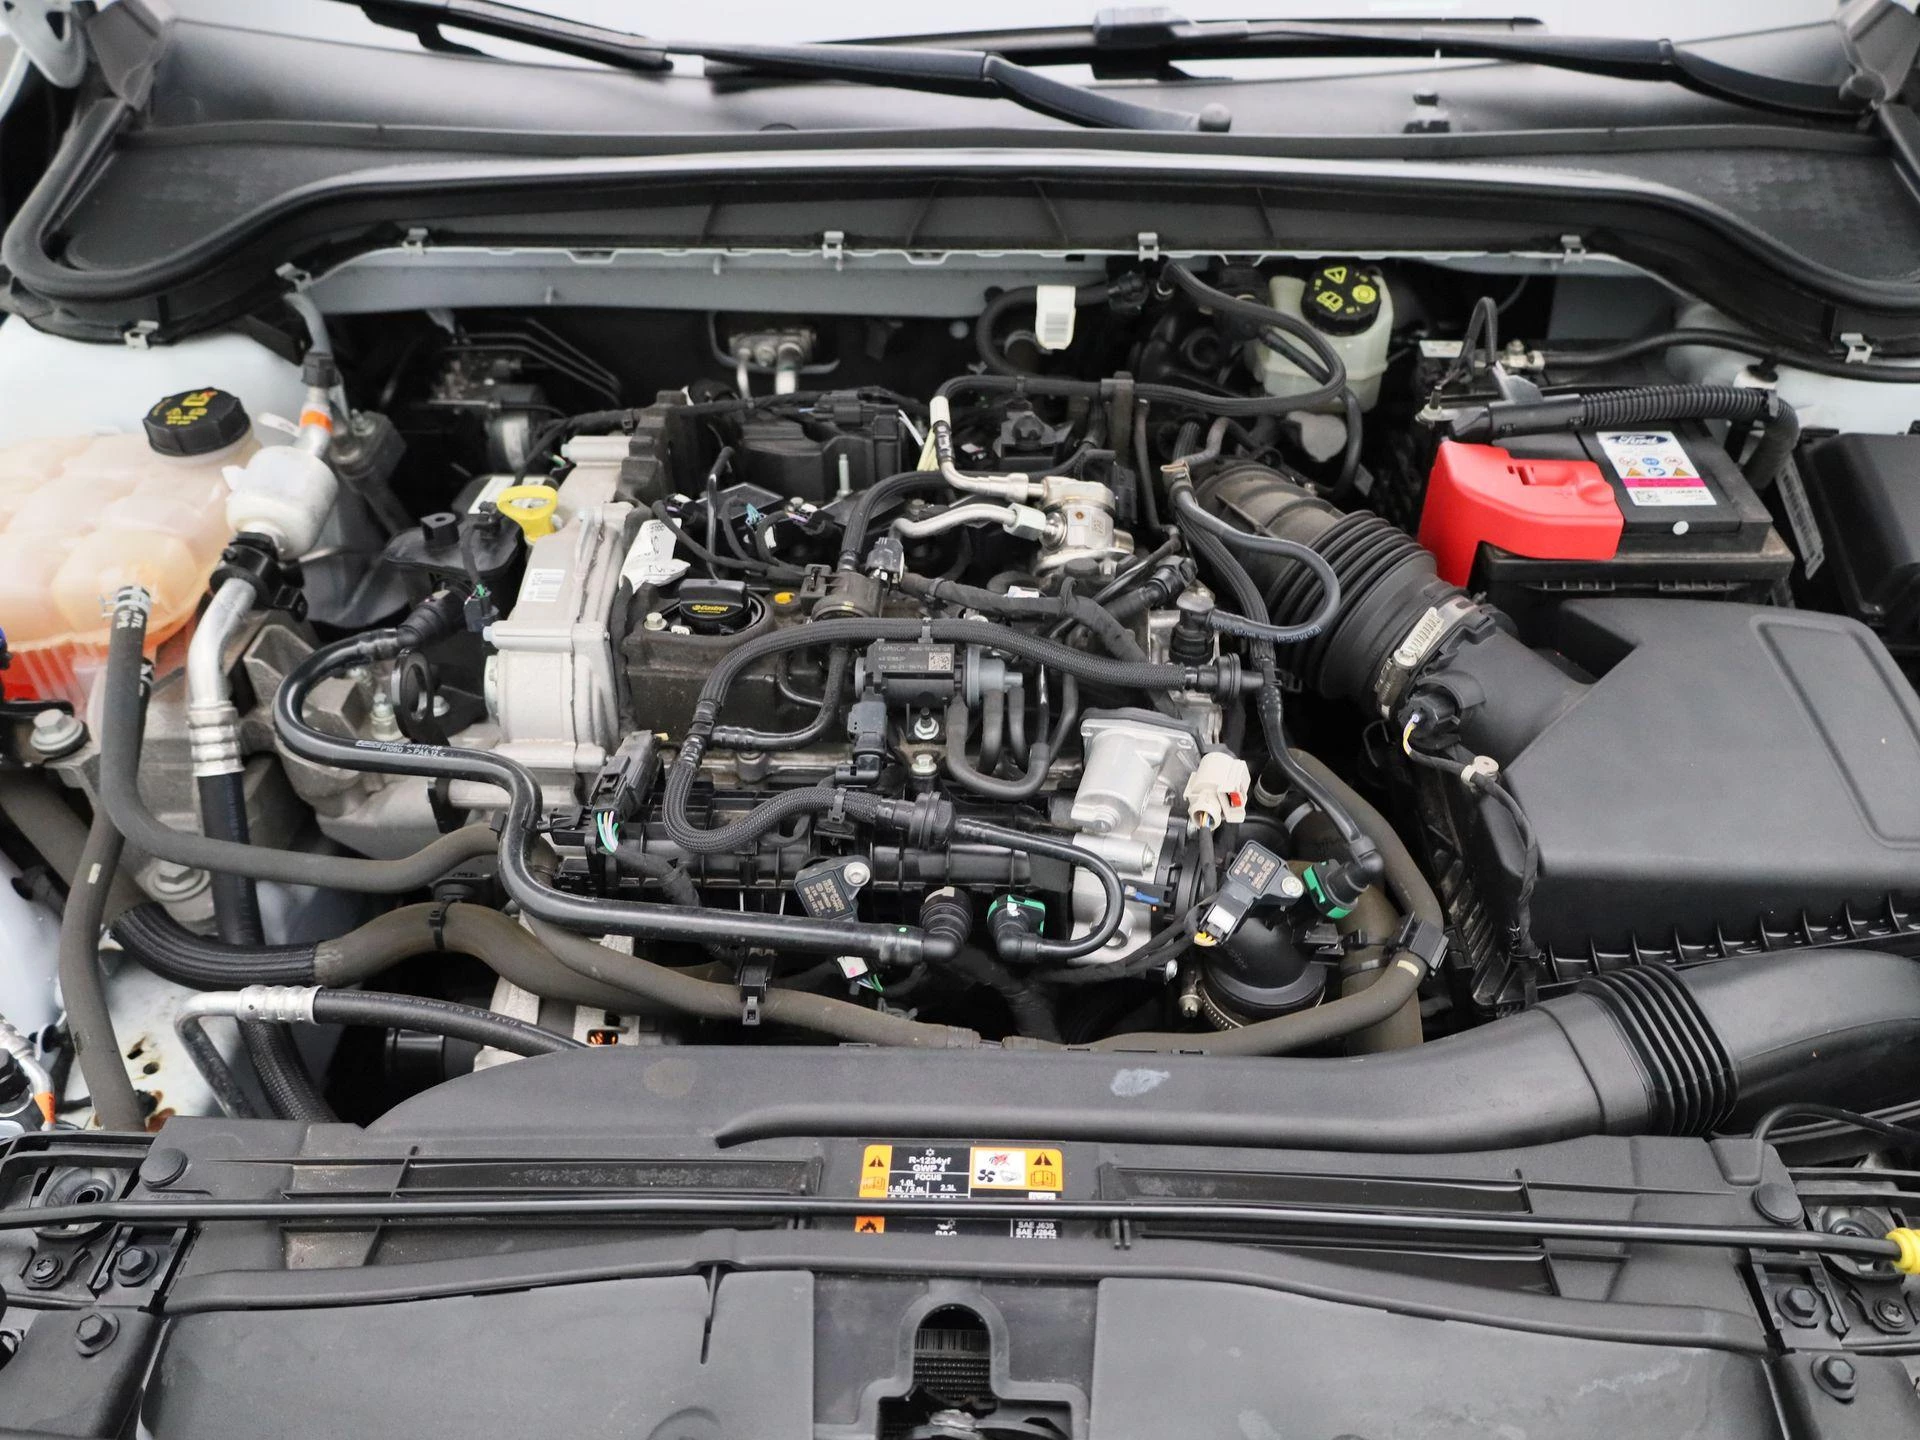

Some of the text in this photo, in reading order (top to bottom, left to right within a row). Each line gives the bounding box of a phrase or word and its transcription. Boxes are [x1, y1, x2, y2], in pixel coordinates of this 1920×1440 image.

[912, 1164, 946, 1172] GWP 4
[914, 1173, 942, 1181] FOCUS
[1018, 1221, 1035, 1229] SAE
[1015, 1228, 1033, 1236] SAE
